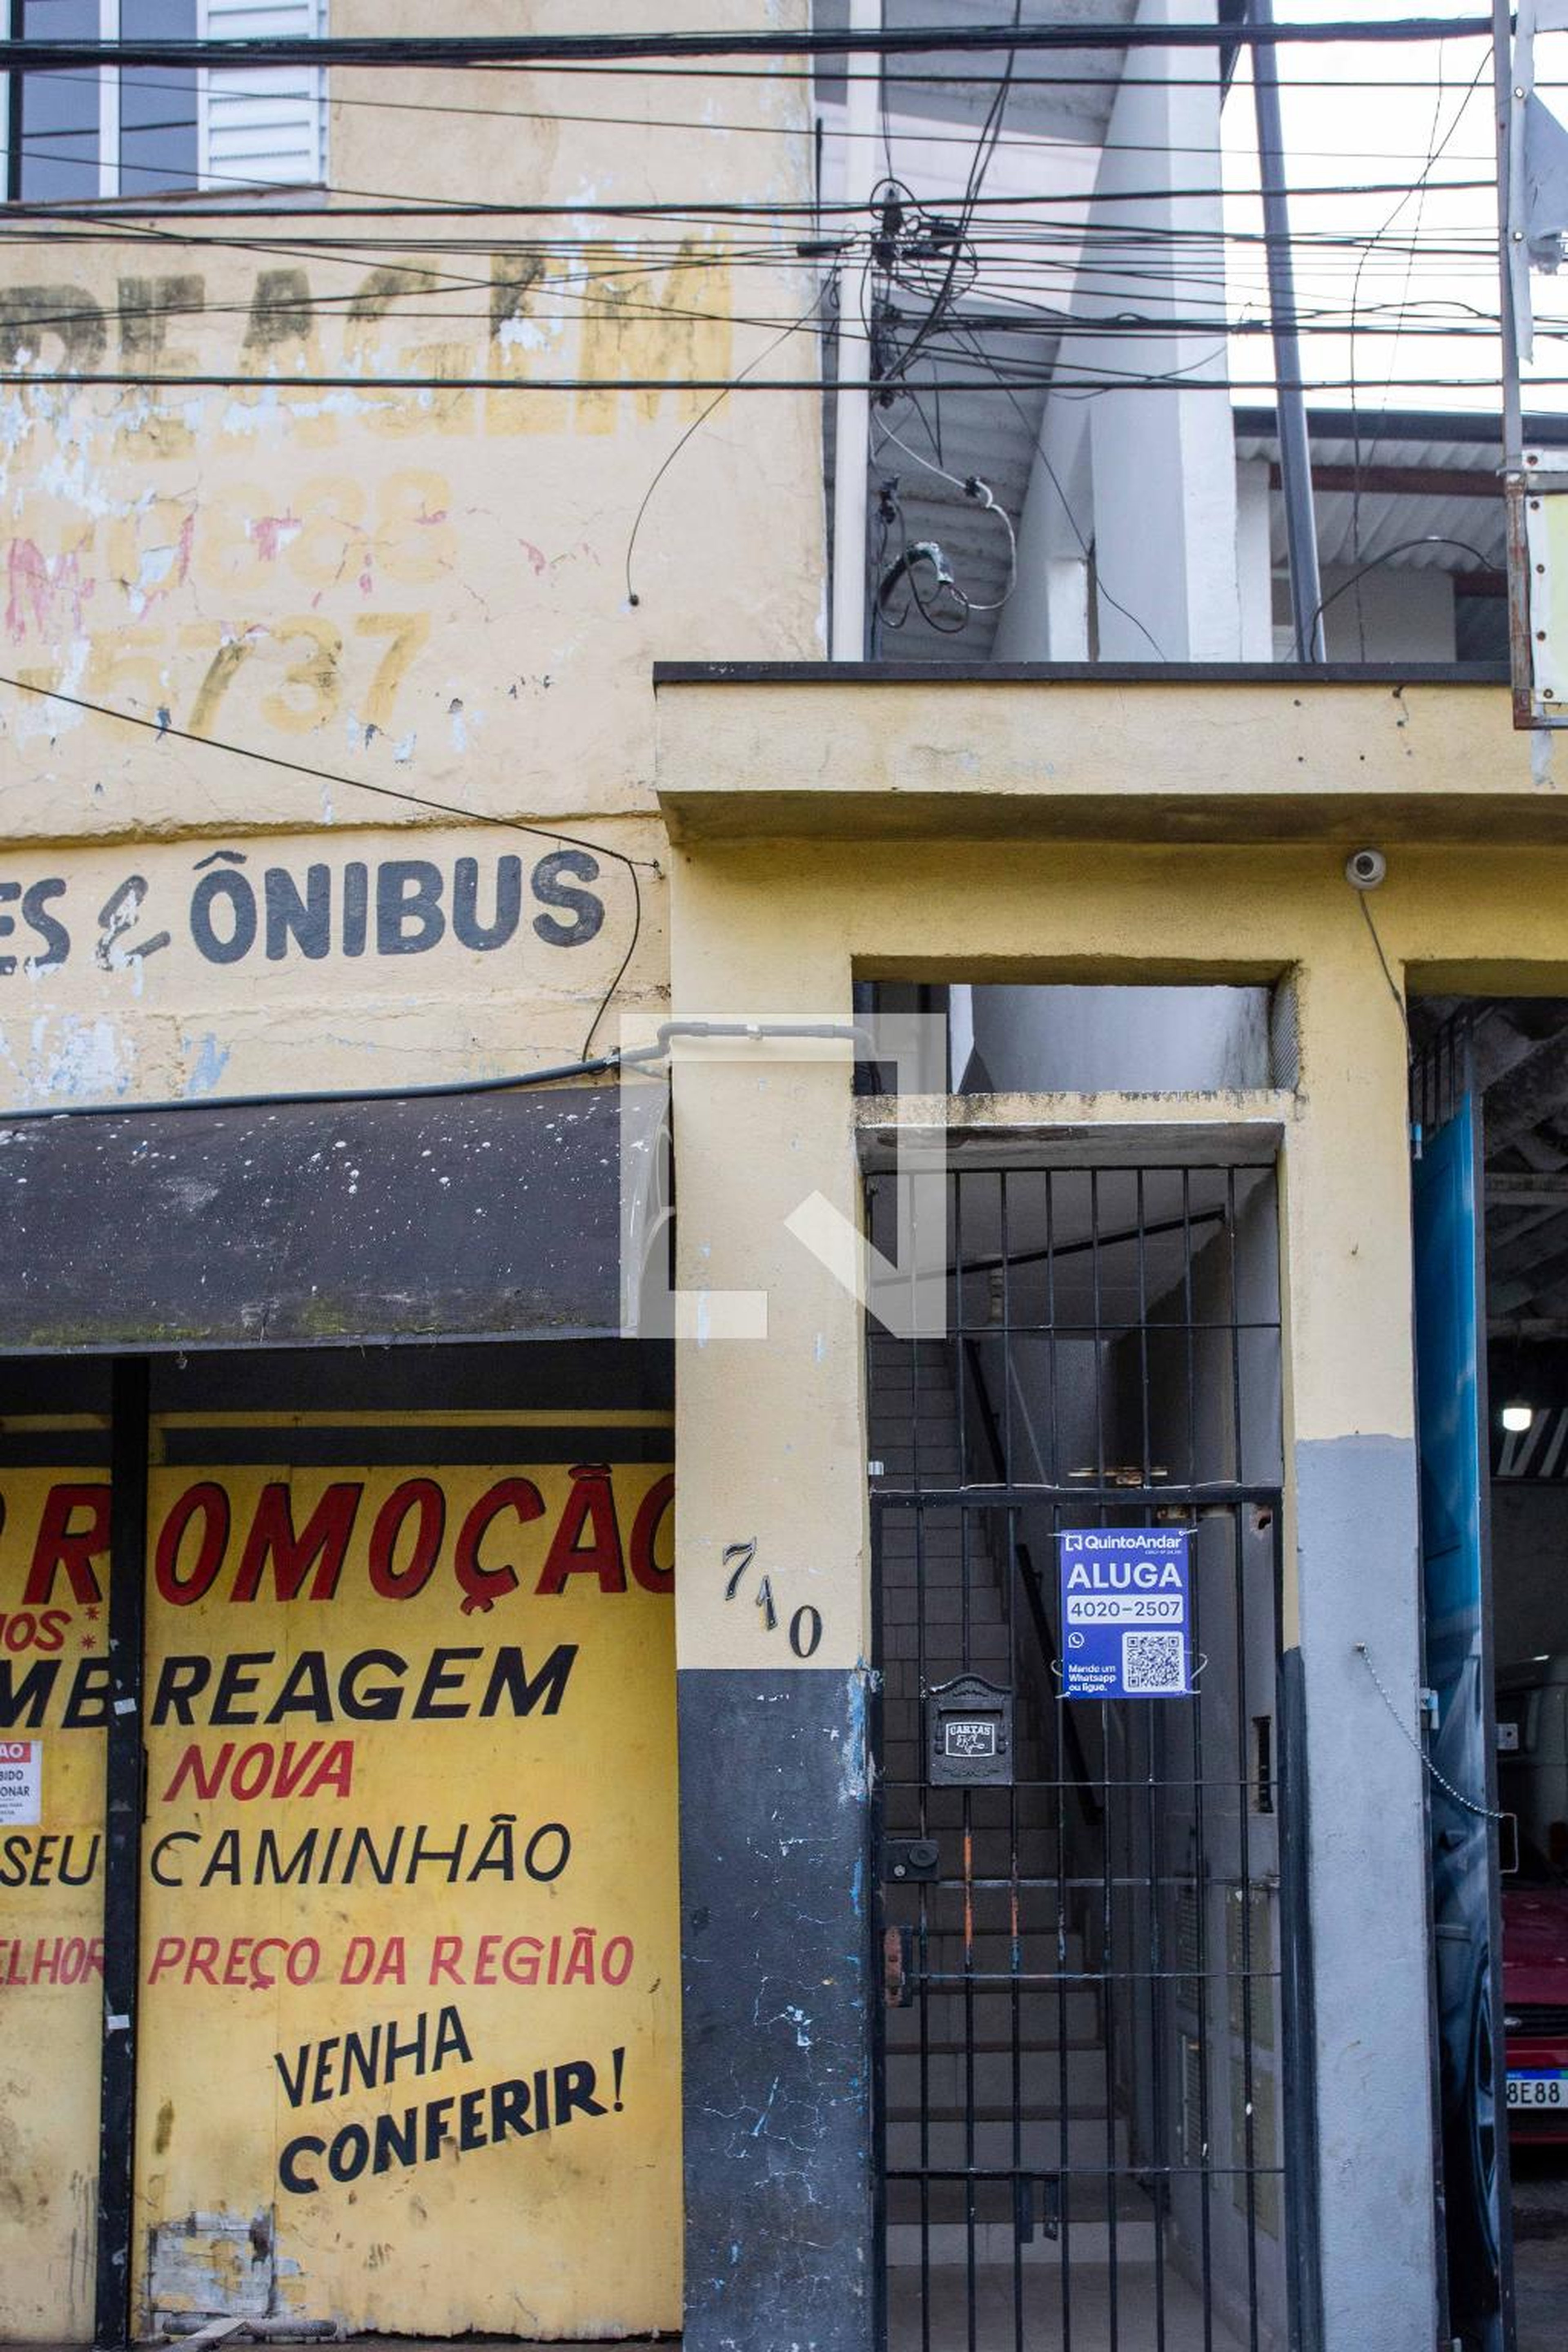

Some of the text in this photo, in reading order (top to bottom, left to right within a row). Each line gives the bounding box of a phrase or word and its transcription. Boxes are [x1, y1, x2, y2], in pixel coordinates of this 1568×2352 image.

[190, 849, 605, 964] ÔNIBUS
[0, 1464, 676, 1615] ROMOÇÃO
[1085, 1535, 1181, 1550] QuintoAndar
[722, 1536, 822, 1658] 710
[1067, 1563, 1183, 1589] ALUGA
[0, 1610, 72, 1652] OS
[1071, 1601, 1180, 1617] 4020-2507
[1069, 1664, 1100, 1673] Mande
[950, 1725, 991, 1735] CARTAS
[163, 1740, 354, 1802] NOVA
[0, 1814, 572, 1887] SEU CAMINHÃO
[147, 1936, 320, 1991] PREÇO
[340, 1936, 406, 1985] DA
[429, 1927, 635, 1987] REGIÃO
[274, 2005, 474, 2109] VENHA
[278, 2047, 626, 2194] CONFERIR!
